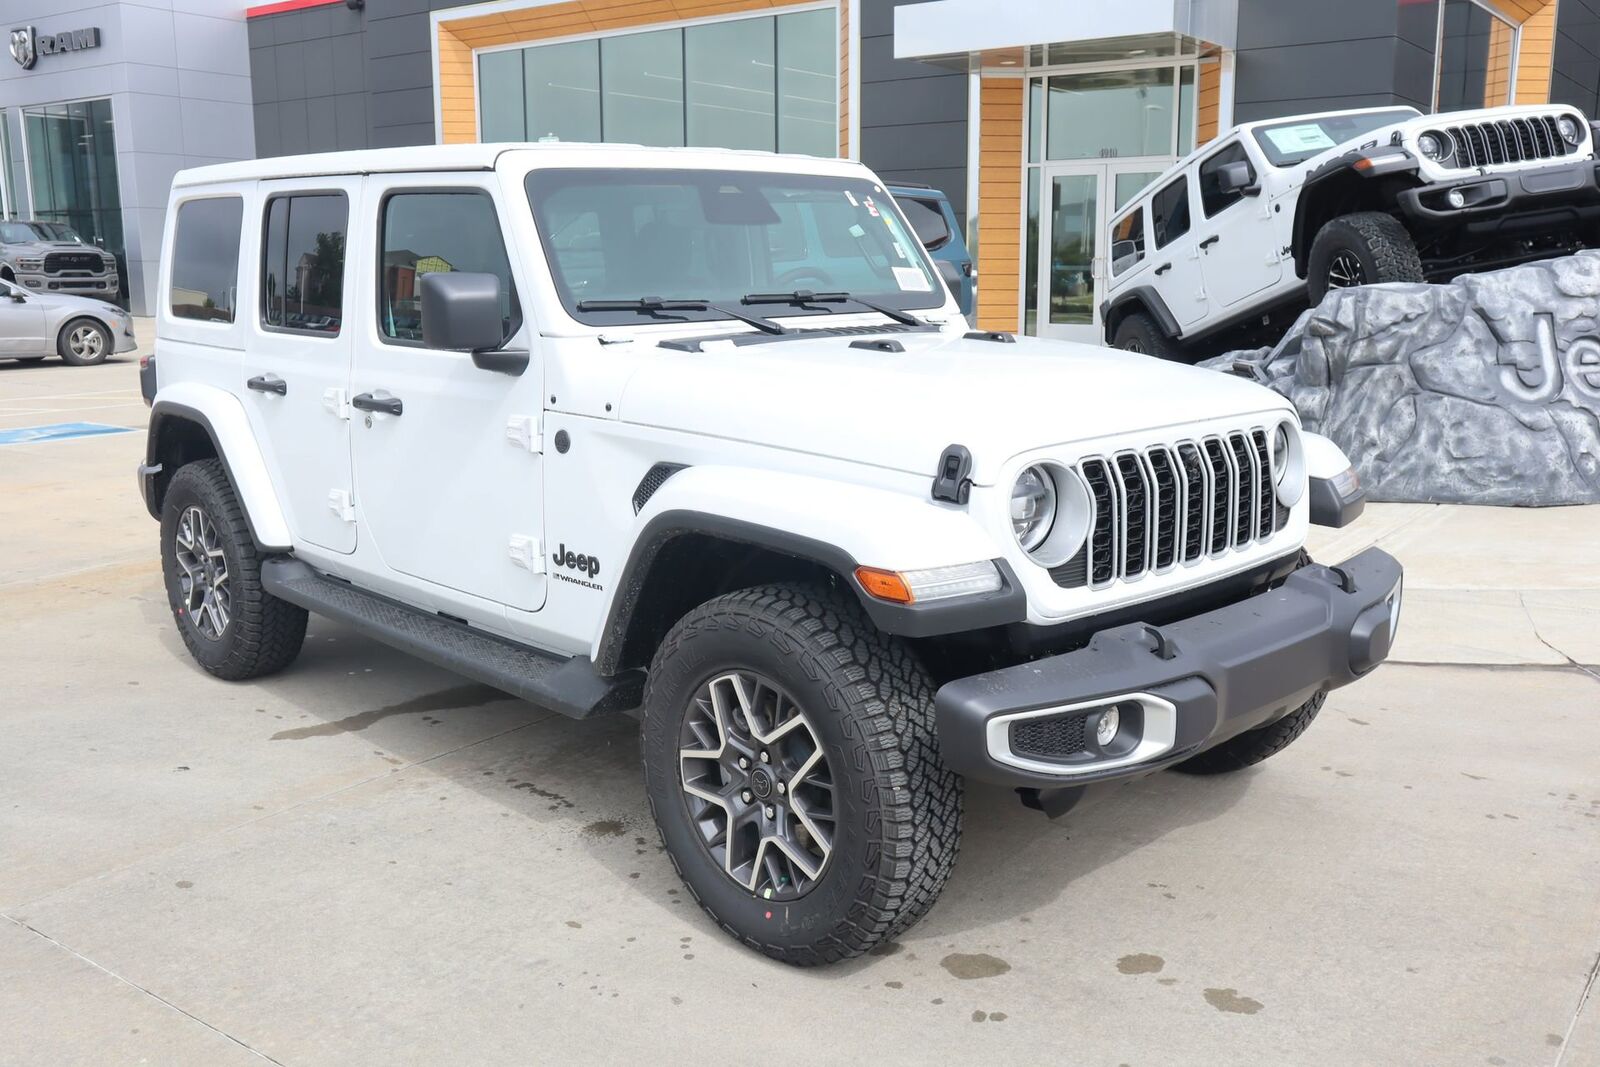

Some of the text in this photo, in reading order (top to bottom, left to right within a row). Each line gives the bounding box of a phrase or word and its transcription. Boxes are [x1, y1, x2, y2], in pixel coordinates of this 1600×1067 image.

[36, 27, 101, 56] RAM
[552, 543, 600, 579] Jeep
[560, 574, 603, 591] WRANGLER
